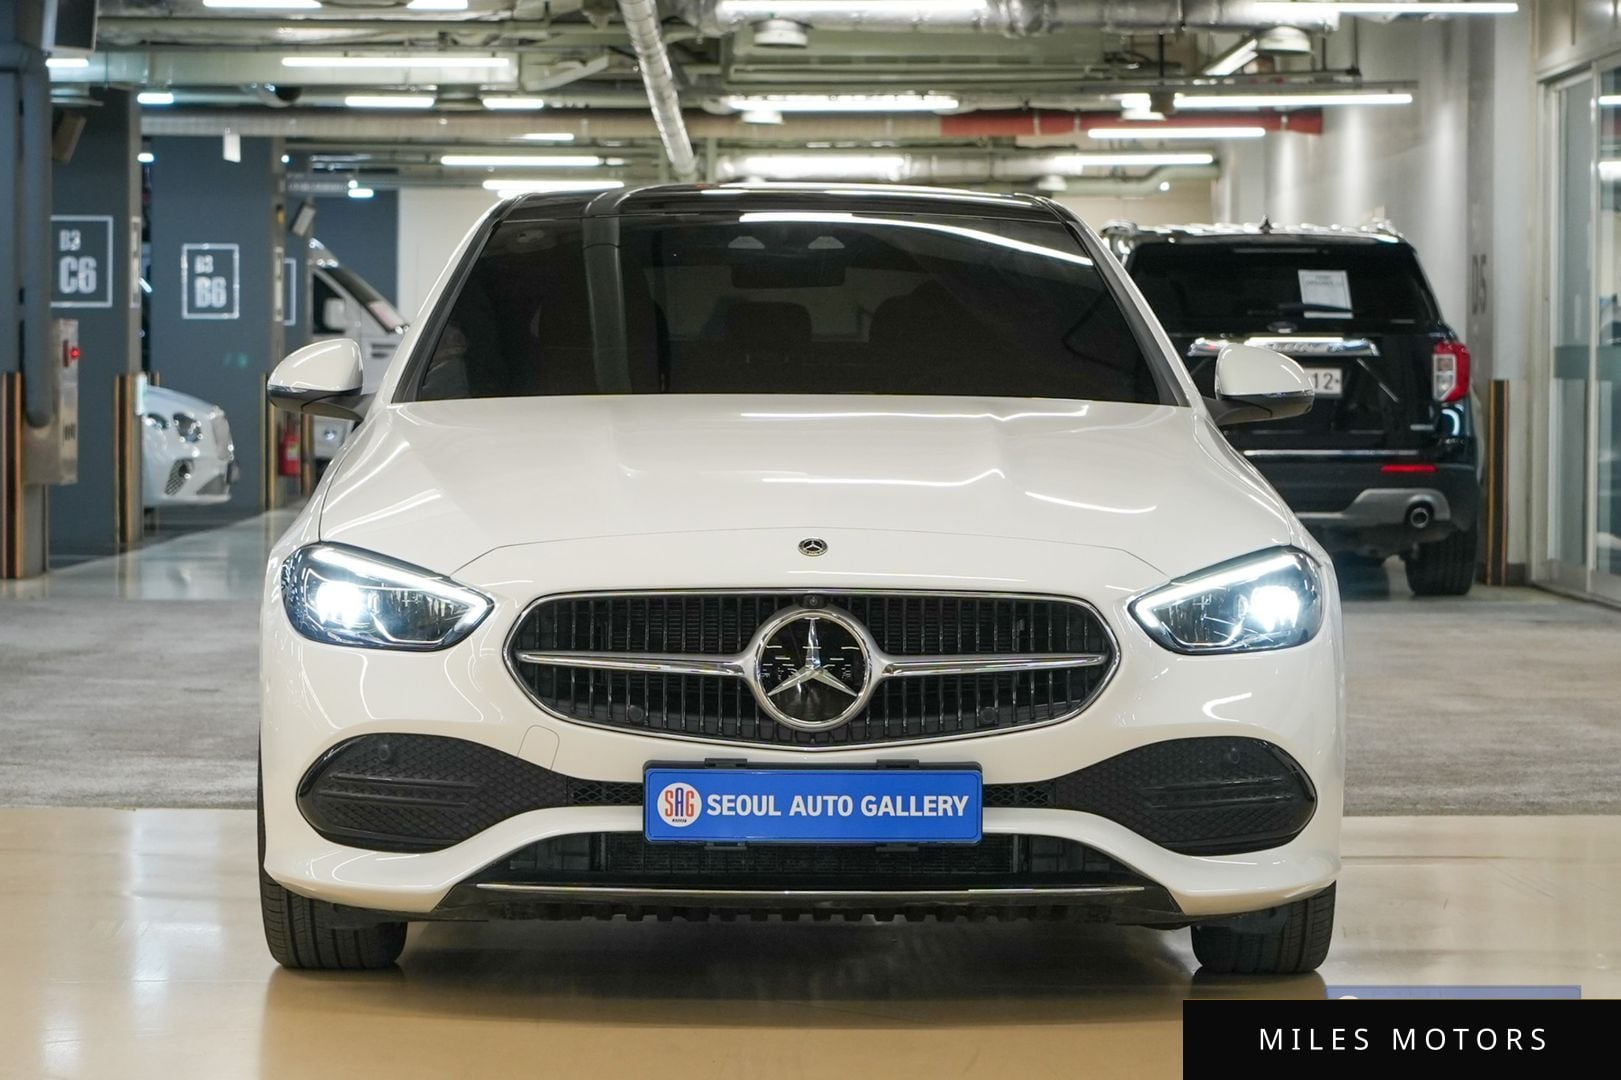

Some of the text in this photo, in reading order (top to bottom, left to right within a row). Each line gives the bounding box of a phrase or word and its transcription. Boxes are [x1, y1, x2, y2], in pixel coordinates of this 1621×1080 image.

[59, 255, 97, 294] C6
[665, 787, 969, 817] SAG SEOUL AUTO GALLERY
